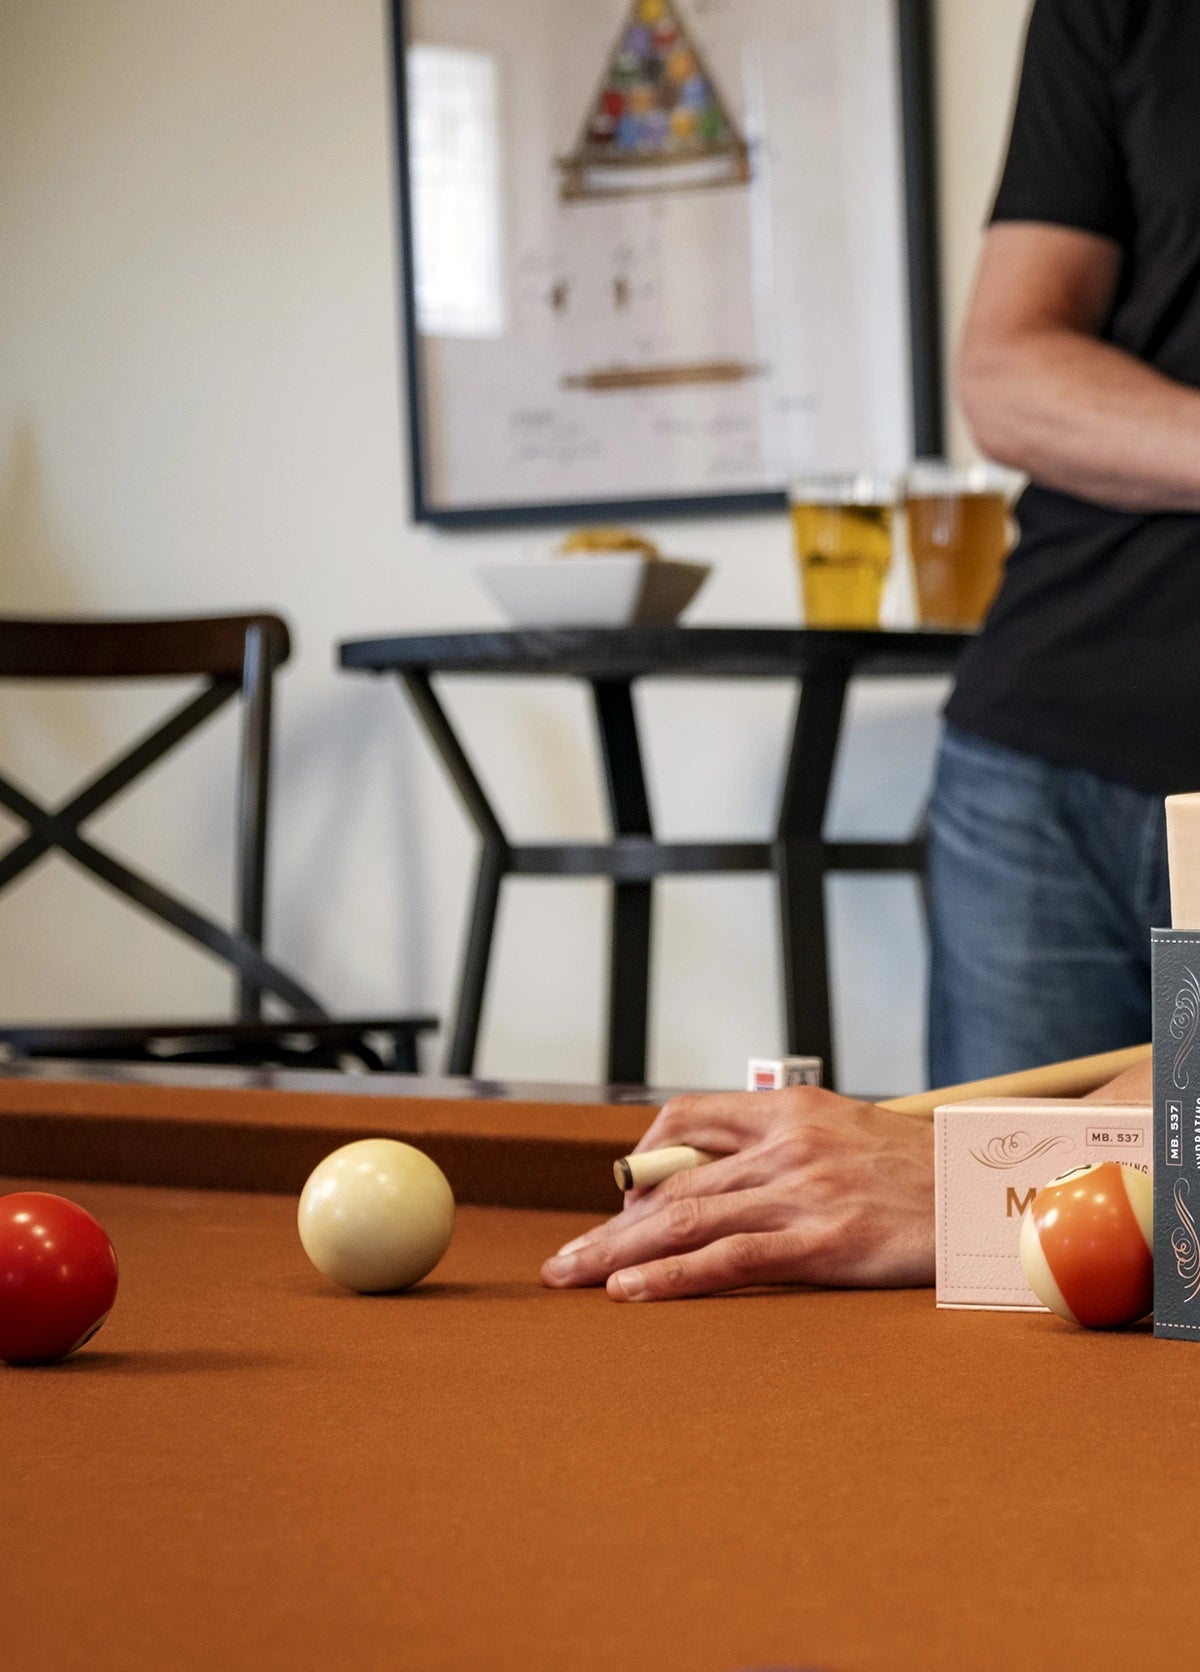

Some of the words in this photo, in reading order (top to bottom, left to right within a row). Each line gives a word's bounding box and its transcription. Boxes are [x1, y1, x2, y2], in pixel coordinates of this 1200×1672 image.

[1170, 1105, 1179, 1131] 537
[1092, 1133, 1112, 1142] MB.
[1118, 1134, 1139, 1142] 537
[1170, 1135, 1179, 1159] MB.
